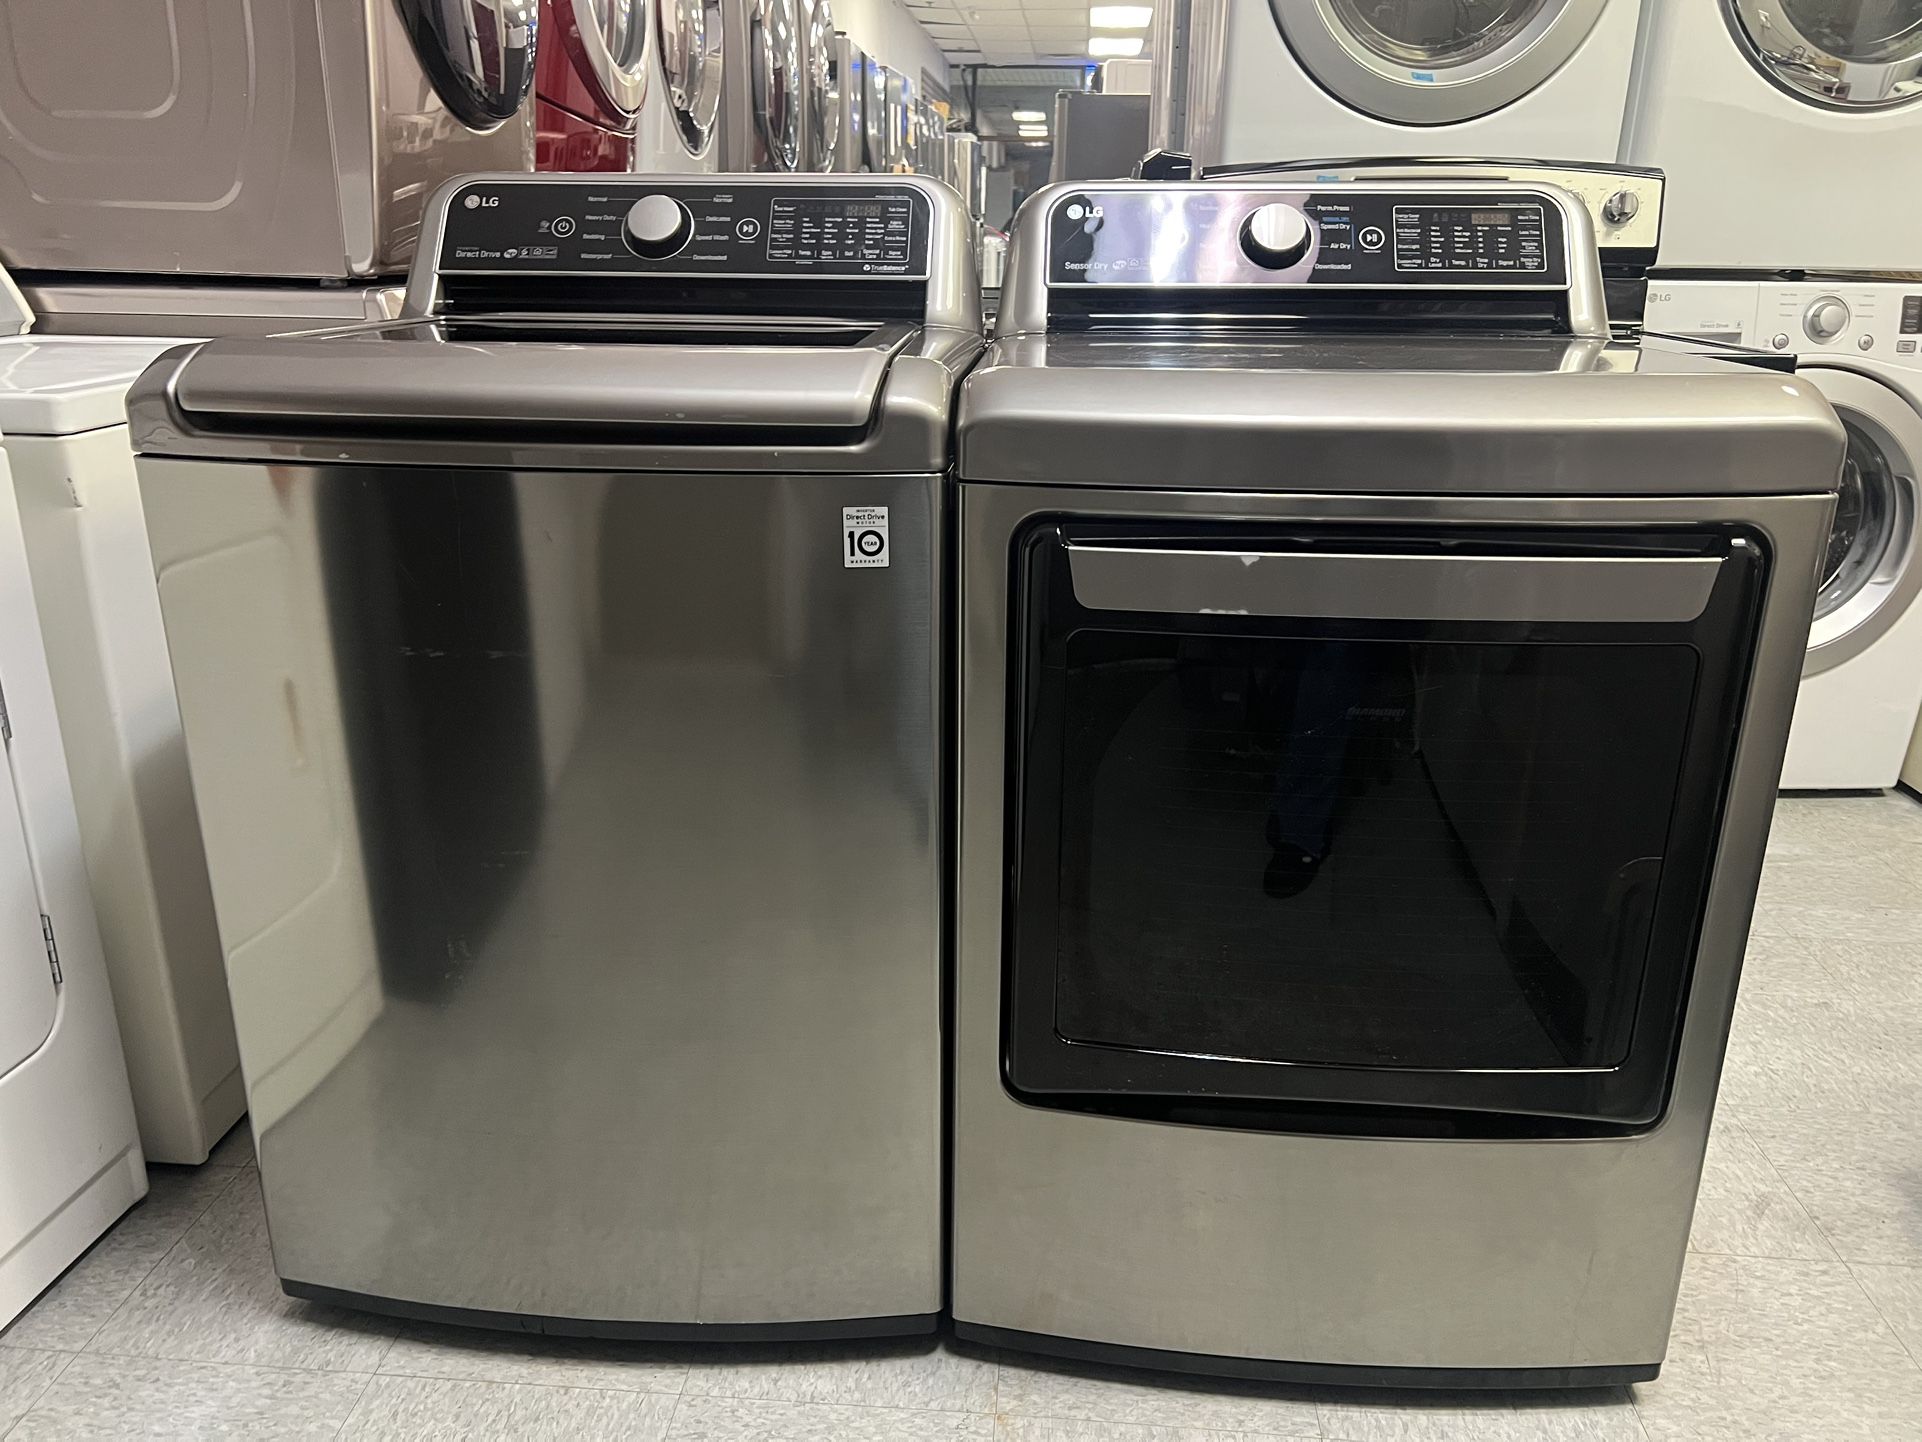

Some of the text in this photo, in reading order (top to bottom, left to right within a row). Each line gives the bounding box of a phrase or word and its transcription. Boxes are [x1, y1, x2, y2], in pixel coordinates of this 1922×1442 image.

[482, 197, 499, 207] LG
[1085, 207, 1103, 217] LG
[1065, 262, 1107, 271] Sensor Dry
[848, 530, 884, 556] 10
